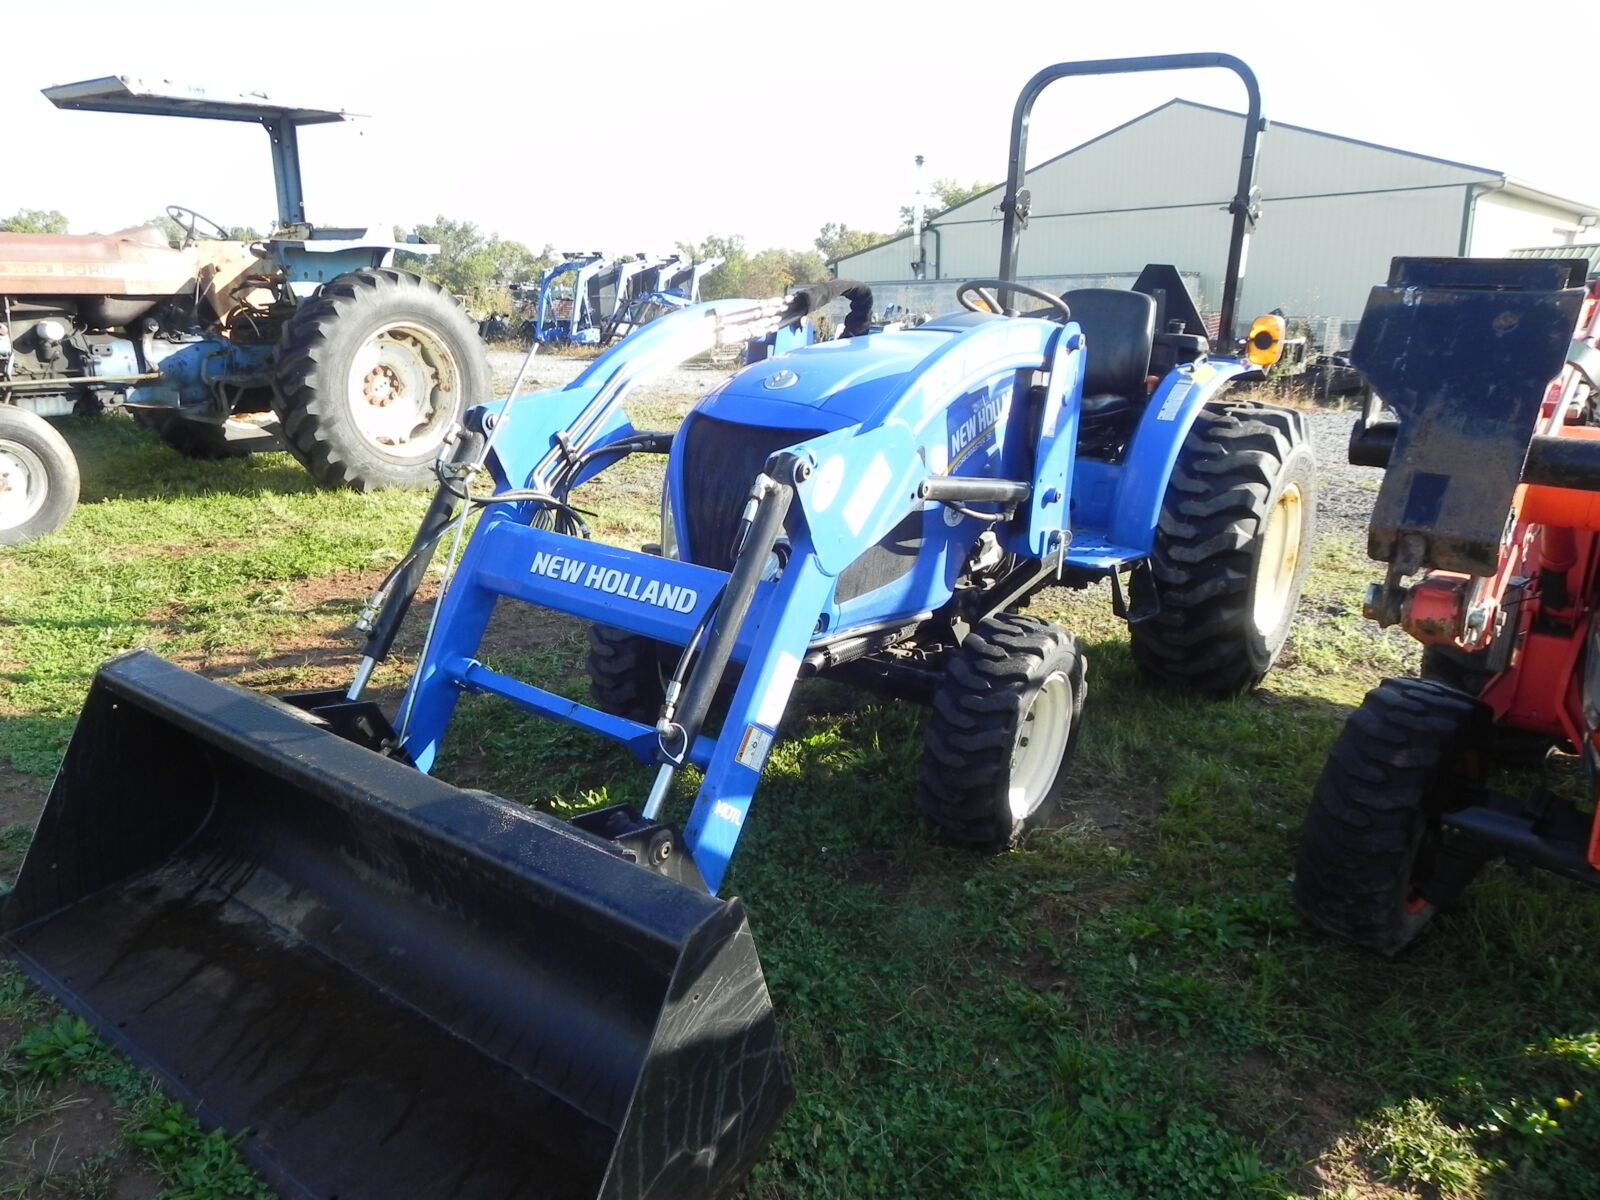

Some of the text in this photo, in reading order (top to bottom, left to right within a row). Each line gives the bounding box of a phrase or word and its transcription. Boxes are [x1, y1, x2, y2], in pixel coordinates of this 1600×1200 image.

[63, 263, 113, 276] FORD
[952, 391, 1013, 458] NEW HOLL
[530, 551, 698, 615] NEW HOLLAND
